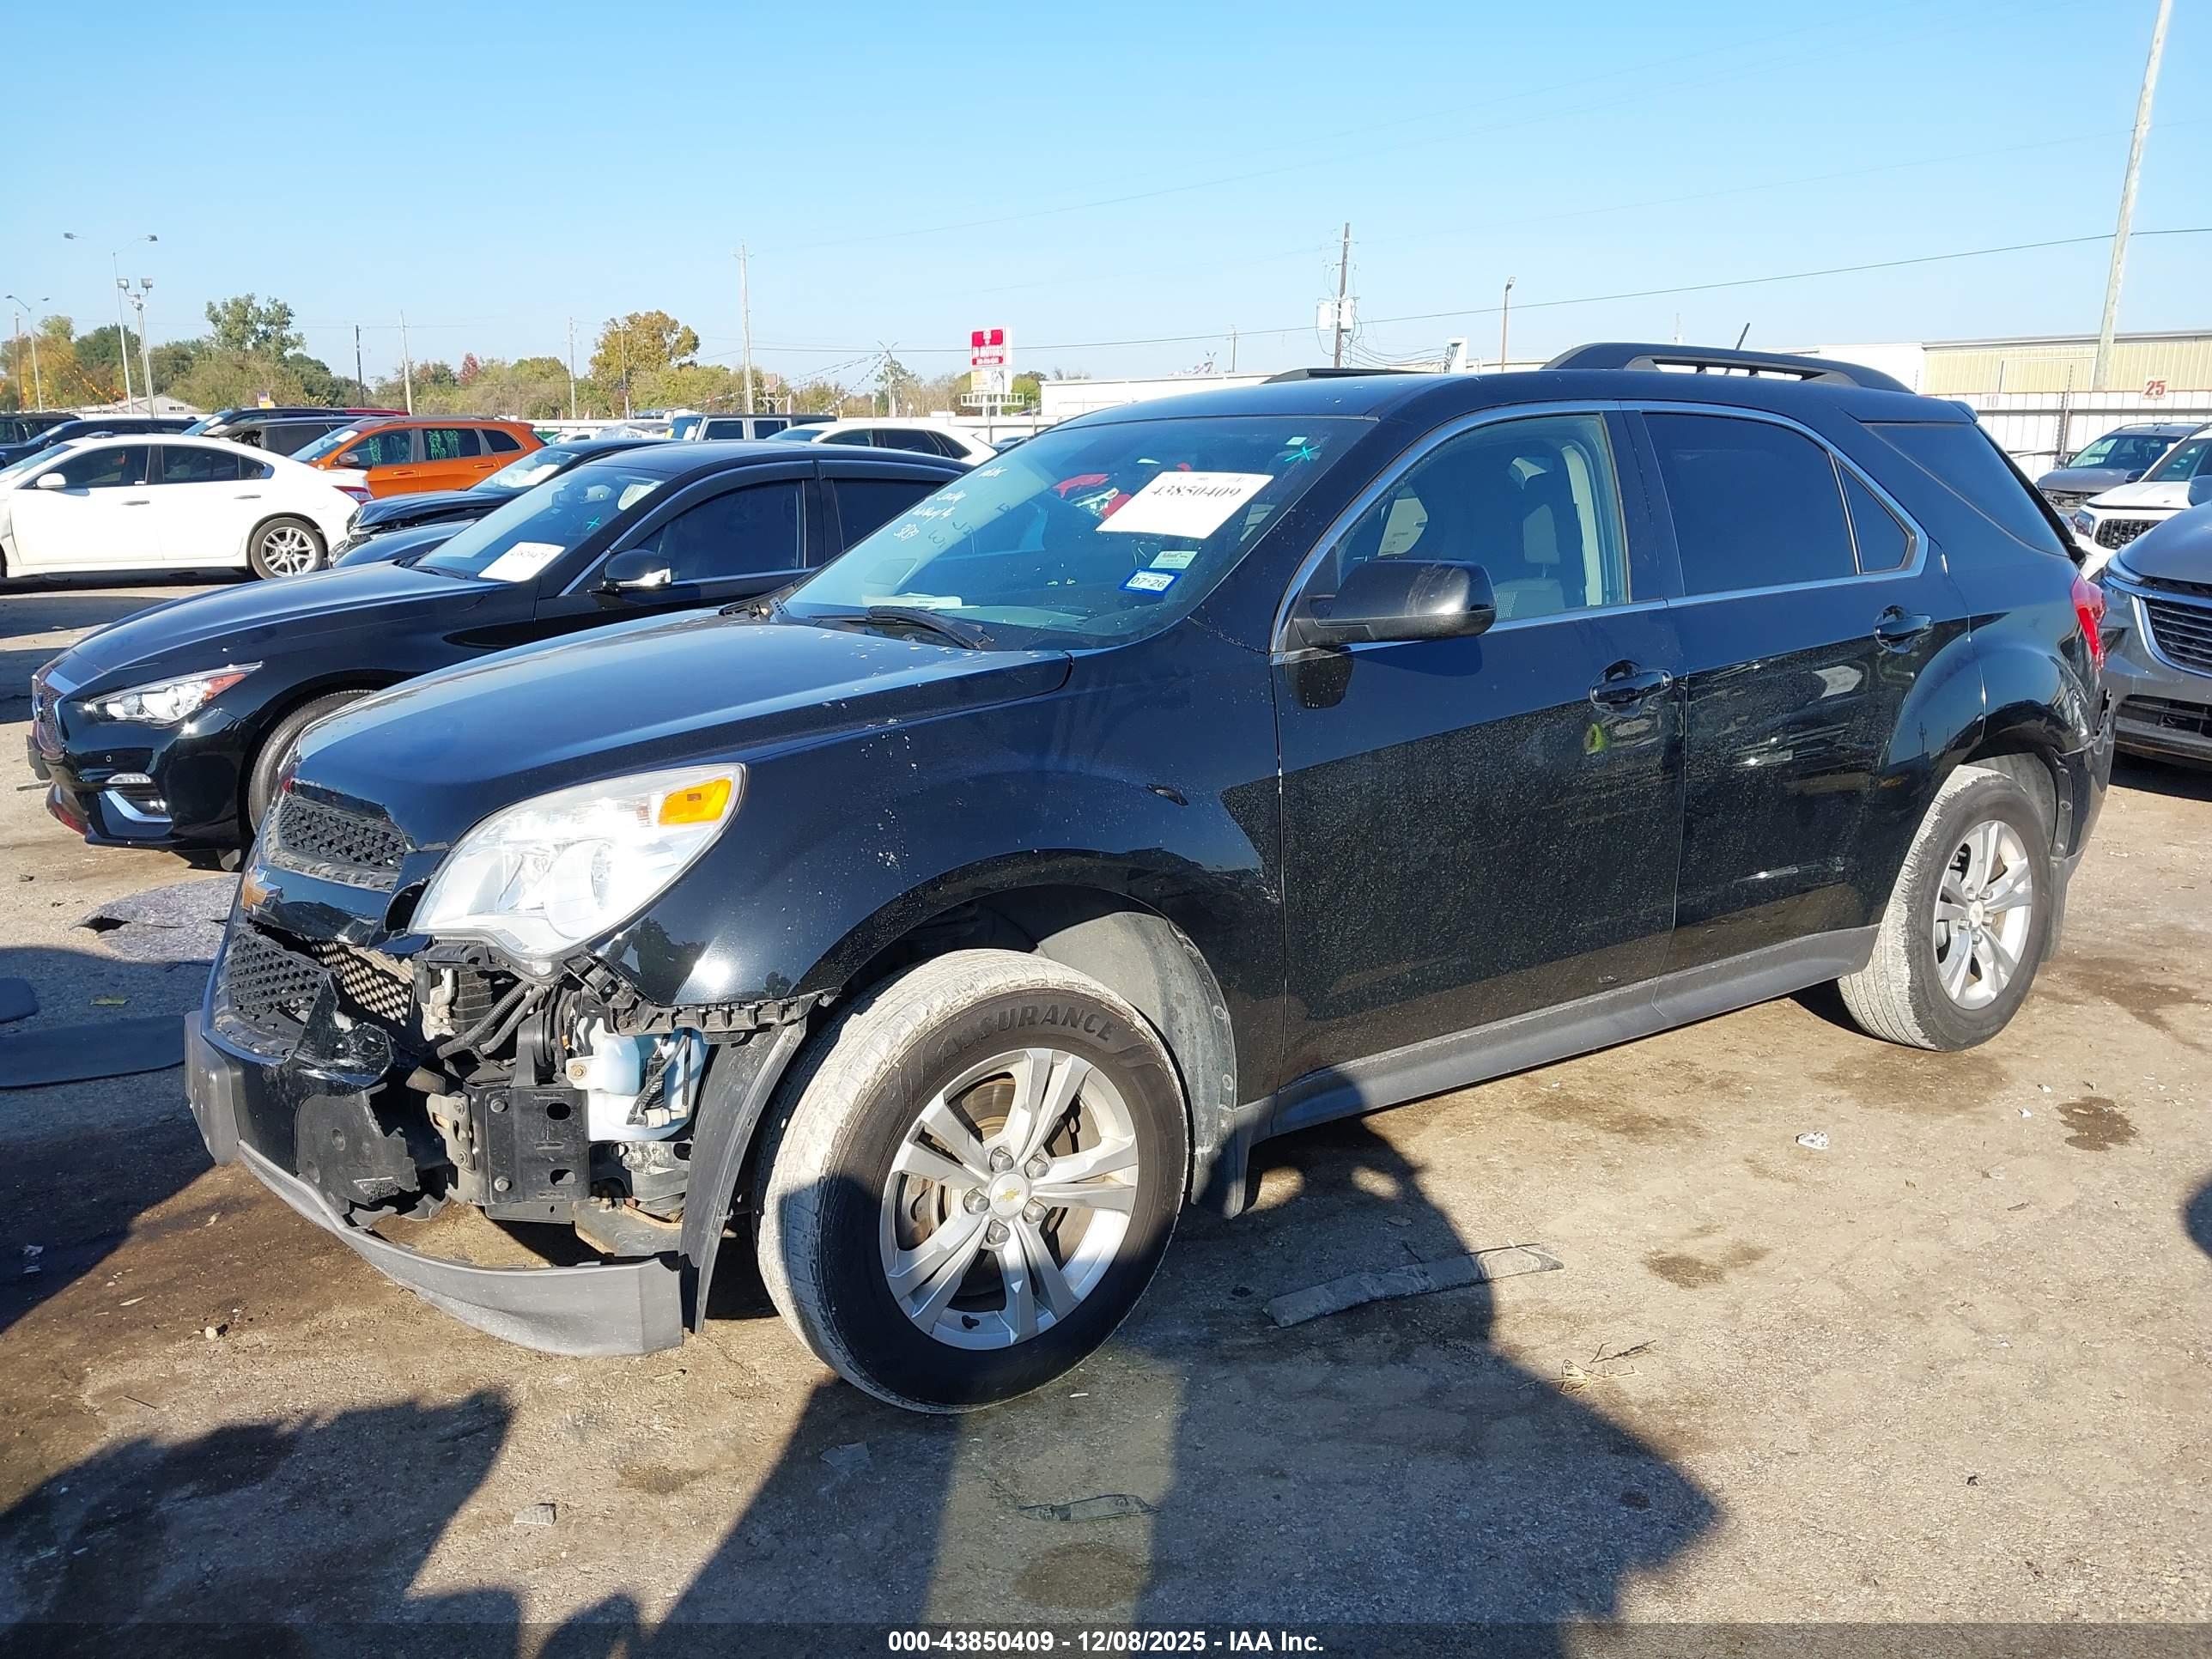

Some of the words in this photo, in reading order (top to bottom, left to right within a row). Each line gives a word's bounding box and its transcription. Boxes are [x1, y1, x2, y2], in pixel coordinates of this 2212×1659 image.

[2145, 380, 2166, 396] 25
[1985, 395, 1999, 408] 10
[1151, 484, 1243, 498] 43850409
